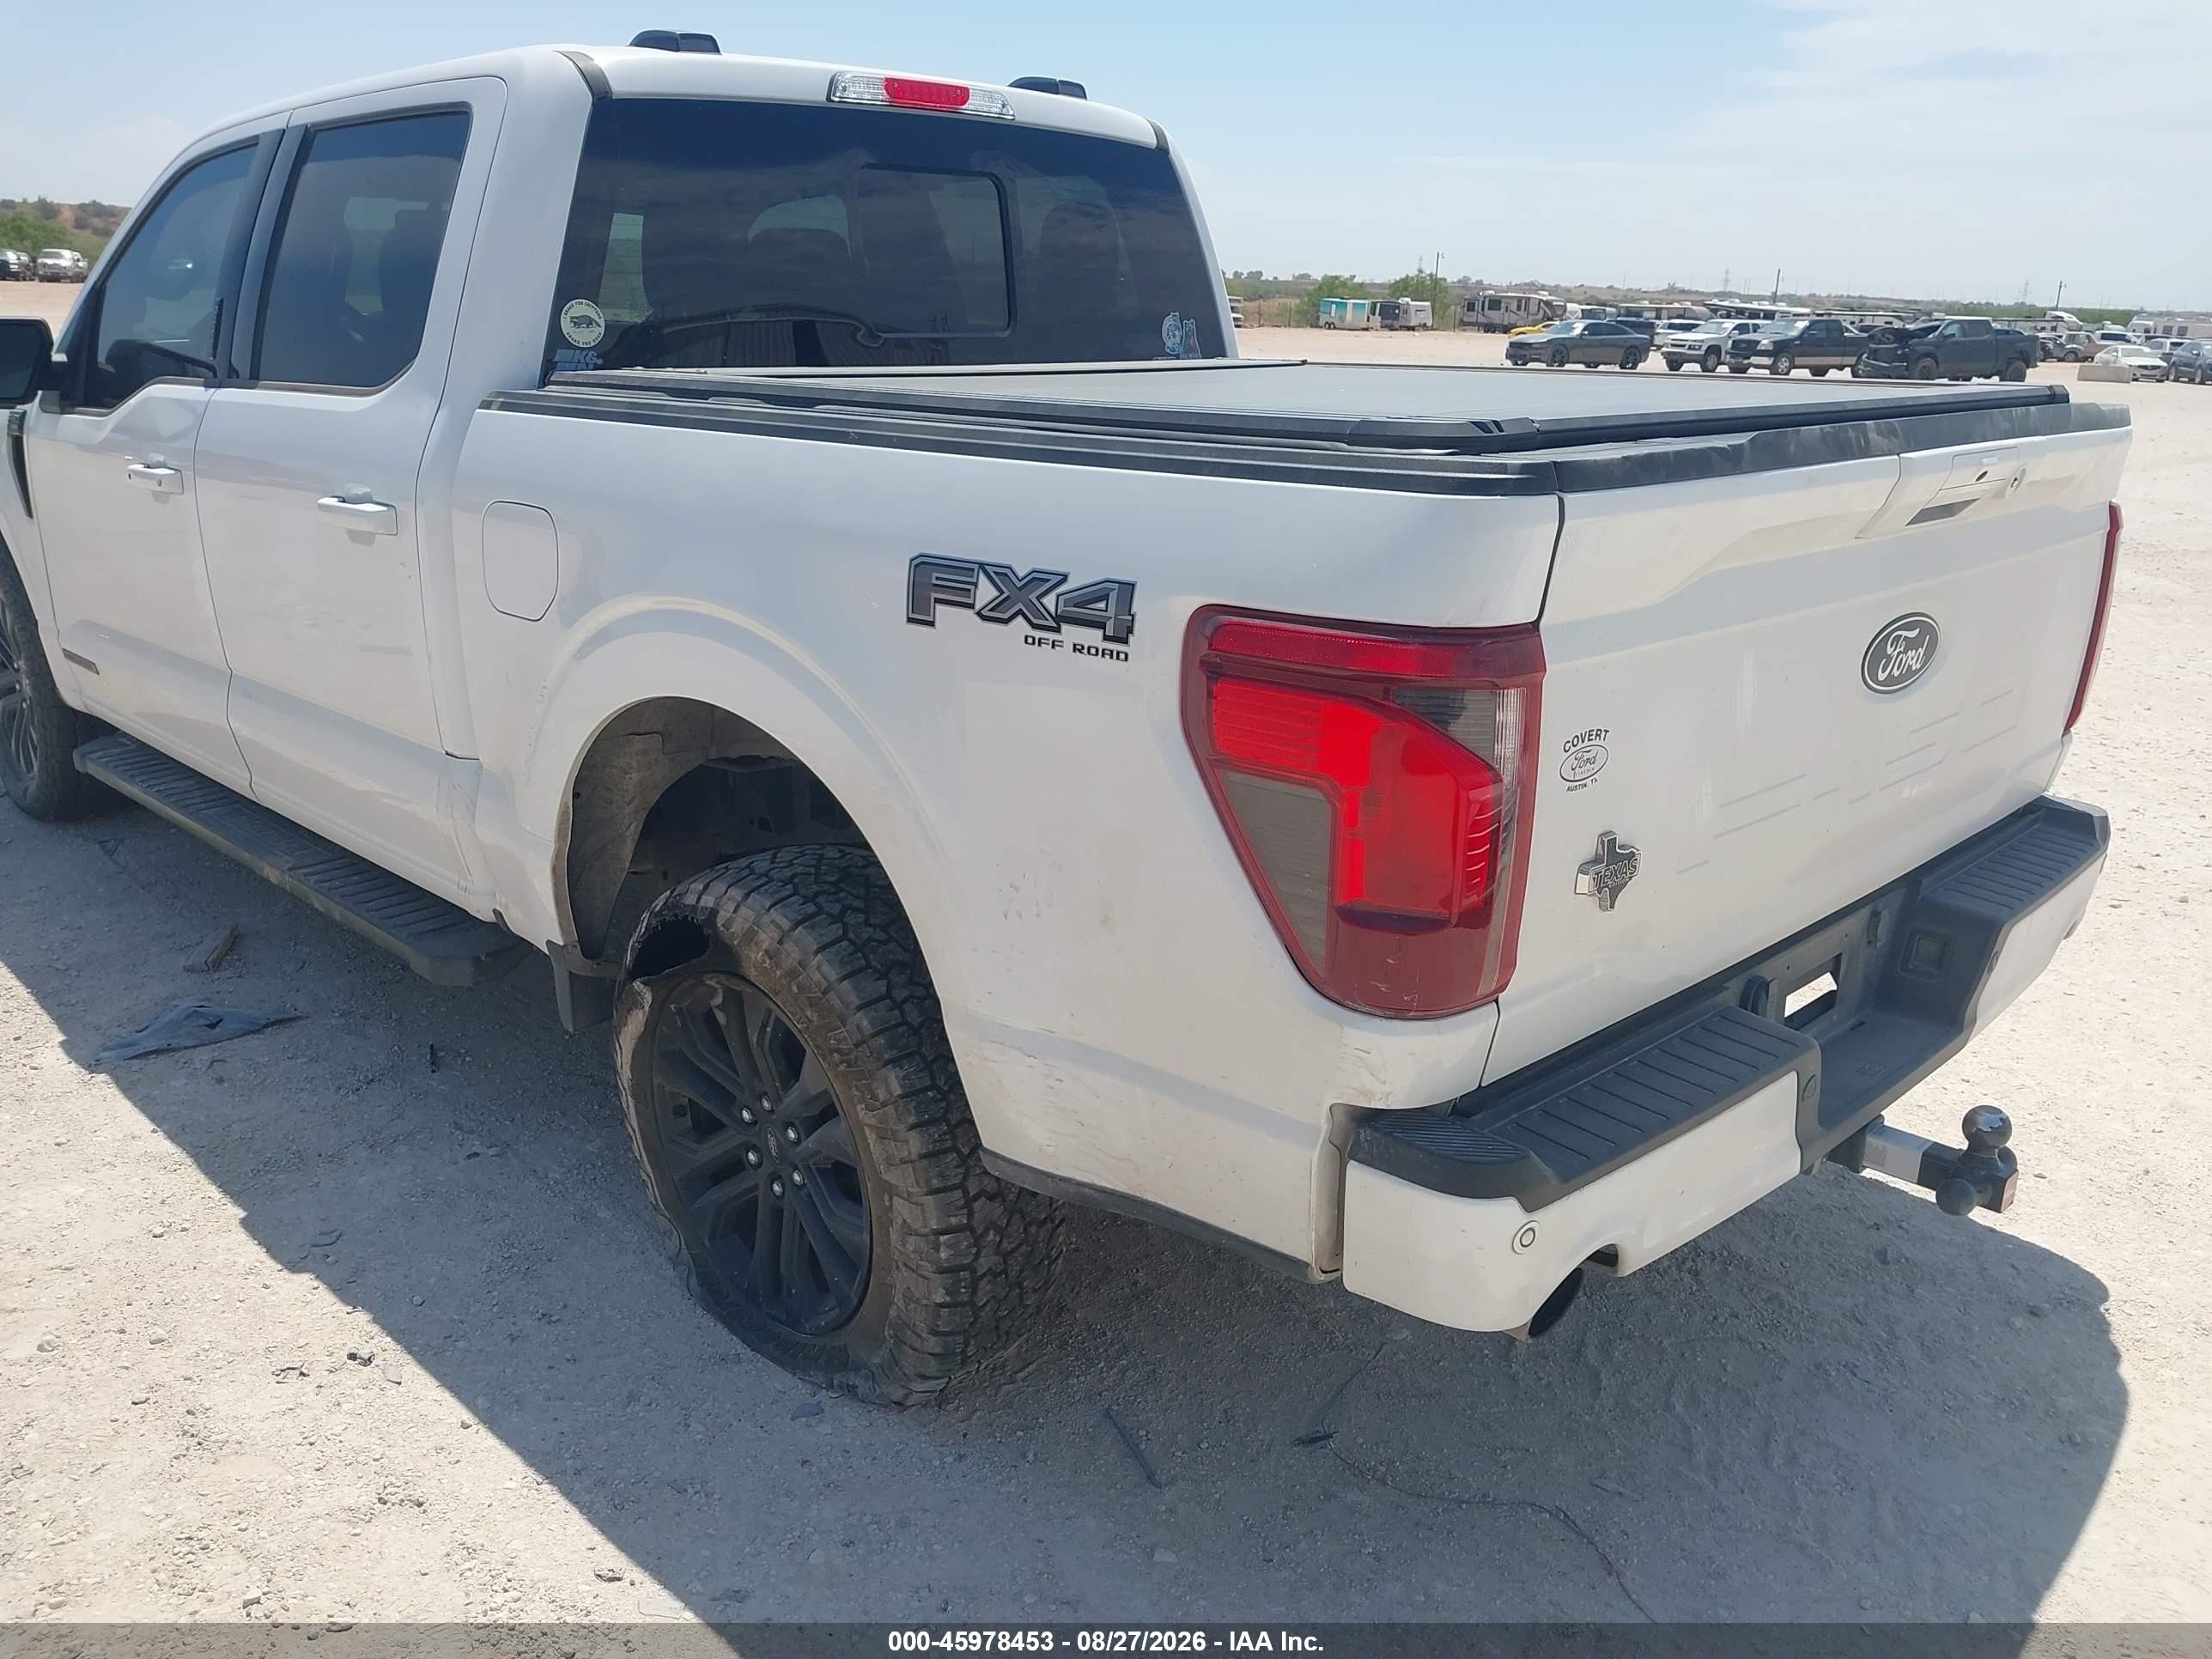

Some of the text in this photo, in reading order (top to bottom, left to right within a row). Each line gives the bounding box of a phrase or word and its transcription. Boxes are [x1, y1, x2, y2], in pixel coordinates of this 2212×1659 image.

[906, 553, 1137, 646] FX4
[1024, 634, 1128, 662] OFF ROAD
[1877, 627, 1929, 681] Ford
[1563, 728, 1610, 753] COVERT
[1571, 749, 1599, 771] Ford
[1593, 857, 1639, 890] TEXAS
